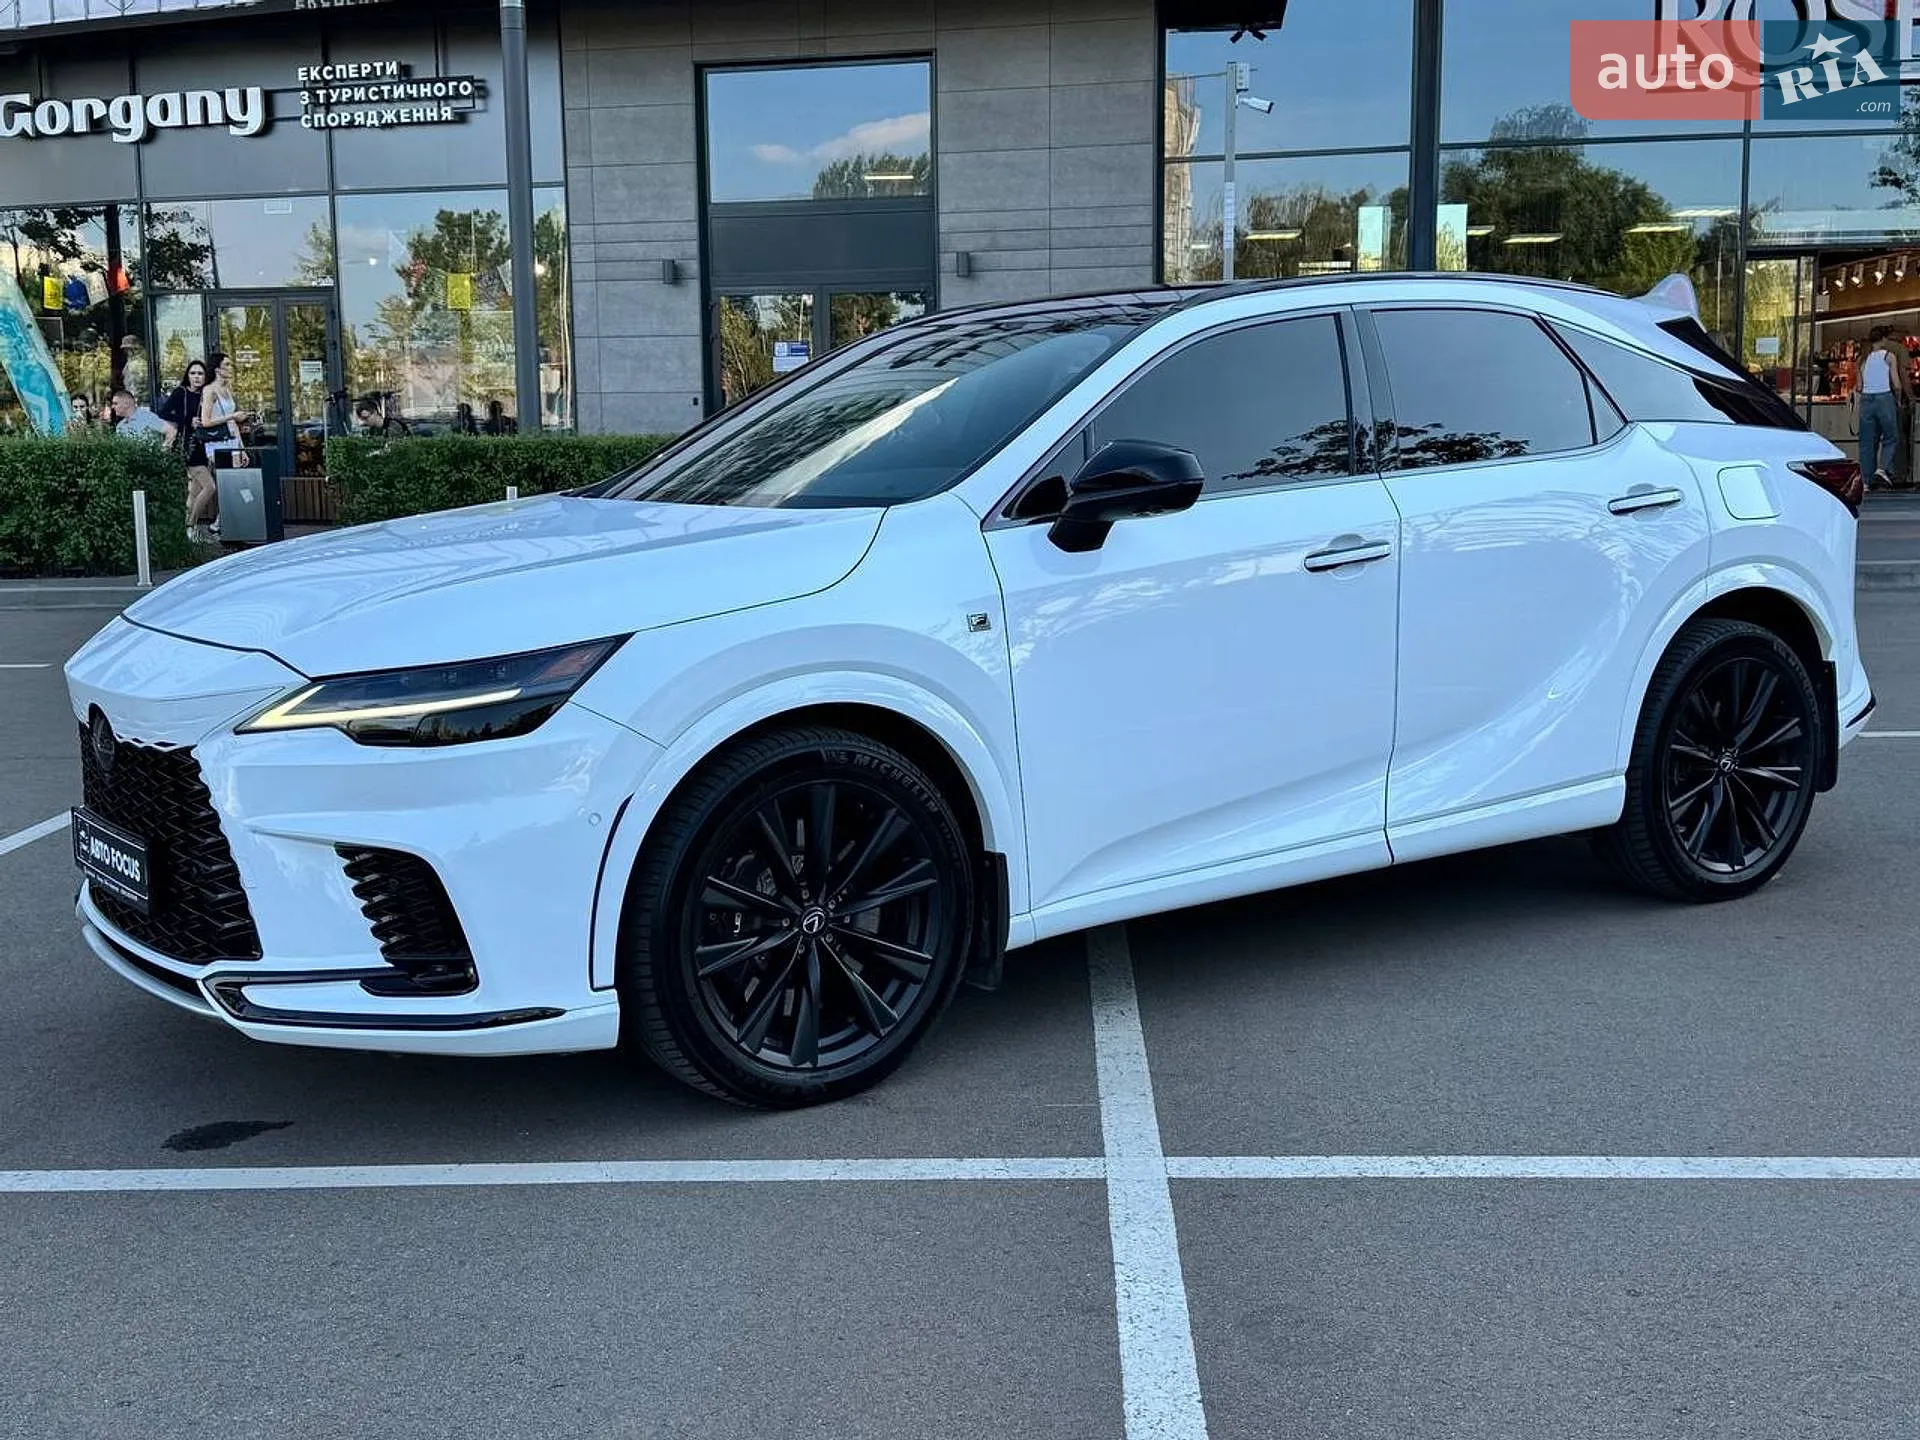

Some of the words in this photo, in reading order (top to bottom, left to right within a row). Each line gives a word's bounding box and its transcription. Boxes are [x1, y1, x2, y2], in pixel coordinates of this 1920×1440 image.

[297, 60, 398, 81] ЕКСПЕРТИ
[316, 81, 473, 104] ТУРИСТИЧНОГО
[0, 86, 264, 143] Gorgany
[301, 106, 453, 128] СПОРЯДЖЕННЯ
[111, 847, 141, 883] FOCUS
